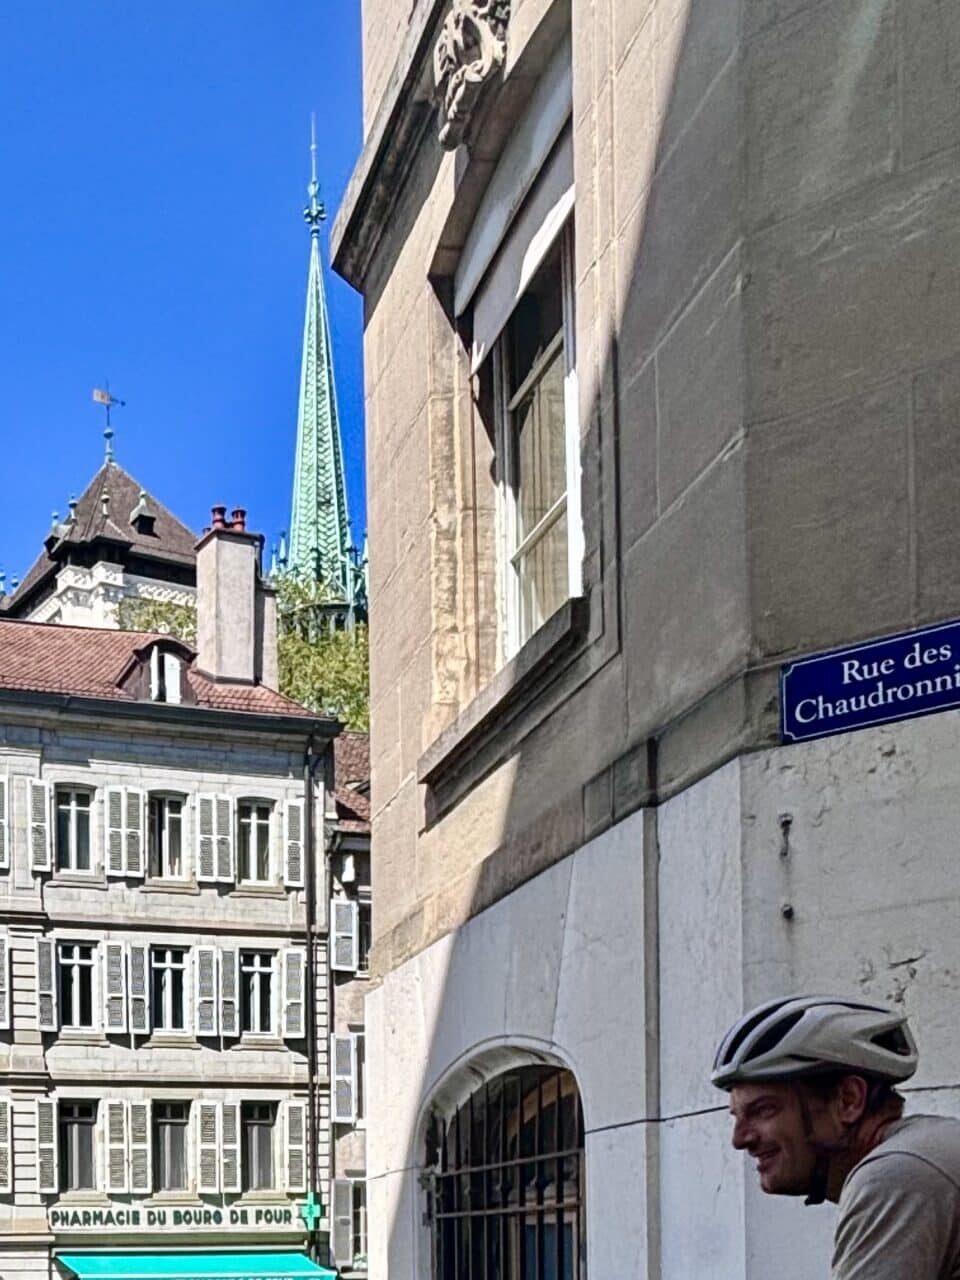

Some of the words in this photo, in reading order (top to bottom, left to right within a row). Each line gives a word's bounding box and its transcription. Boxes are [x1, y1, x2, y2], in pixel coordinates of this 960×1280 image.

[841, 658, 895, 685] Rue
[903, 641, 952, 669] des
[51, 1210, 140, 1227] PHARMACIE
[147, 1210, 166, 1226] DU
[173, 1210, 223, 1225] BOURG
[230, 1209, 248, 1225] DE
[255, 1209, 293, 1225] FOUR
